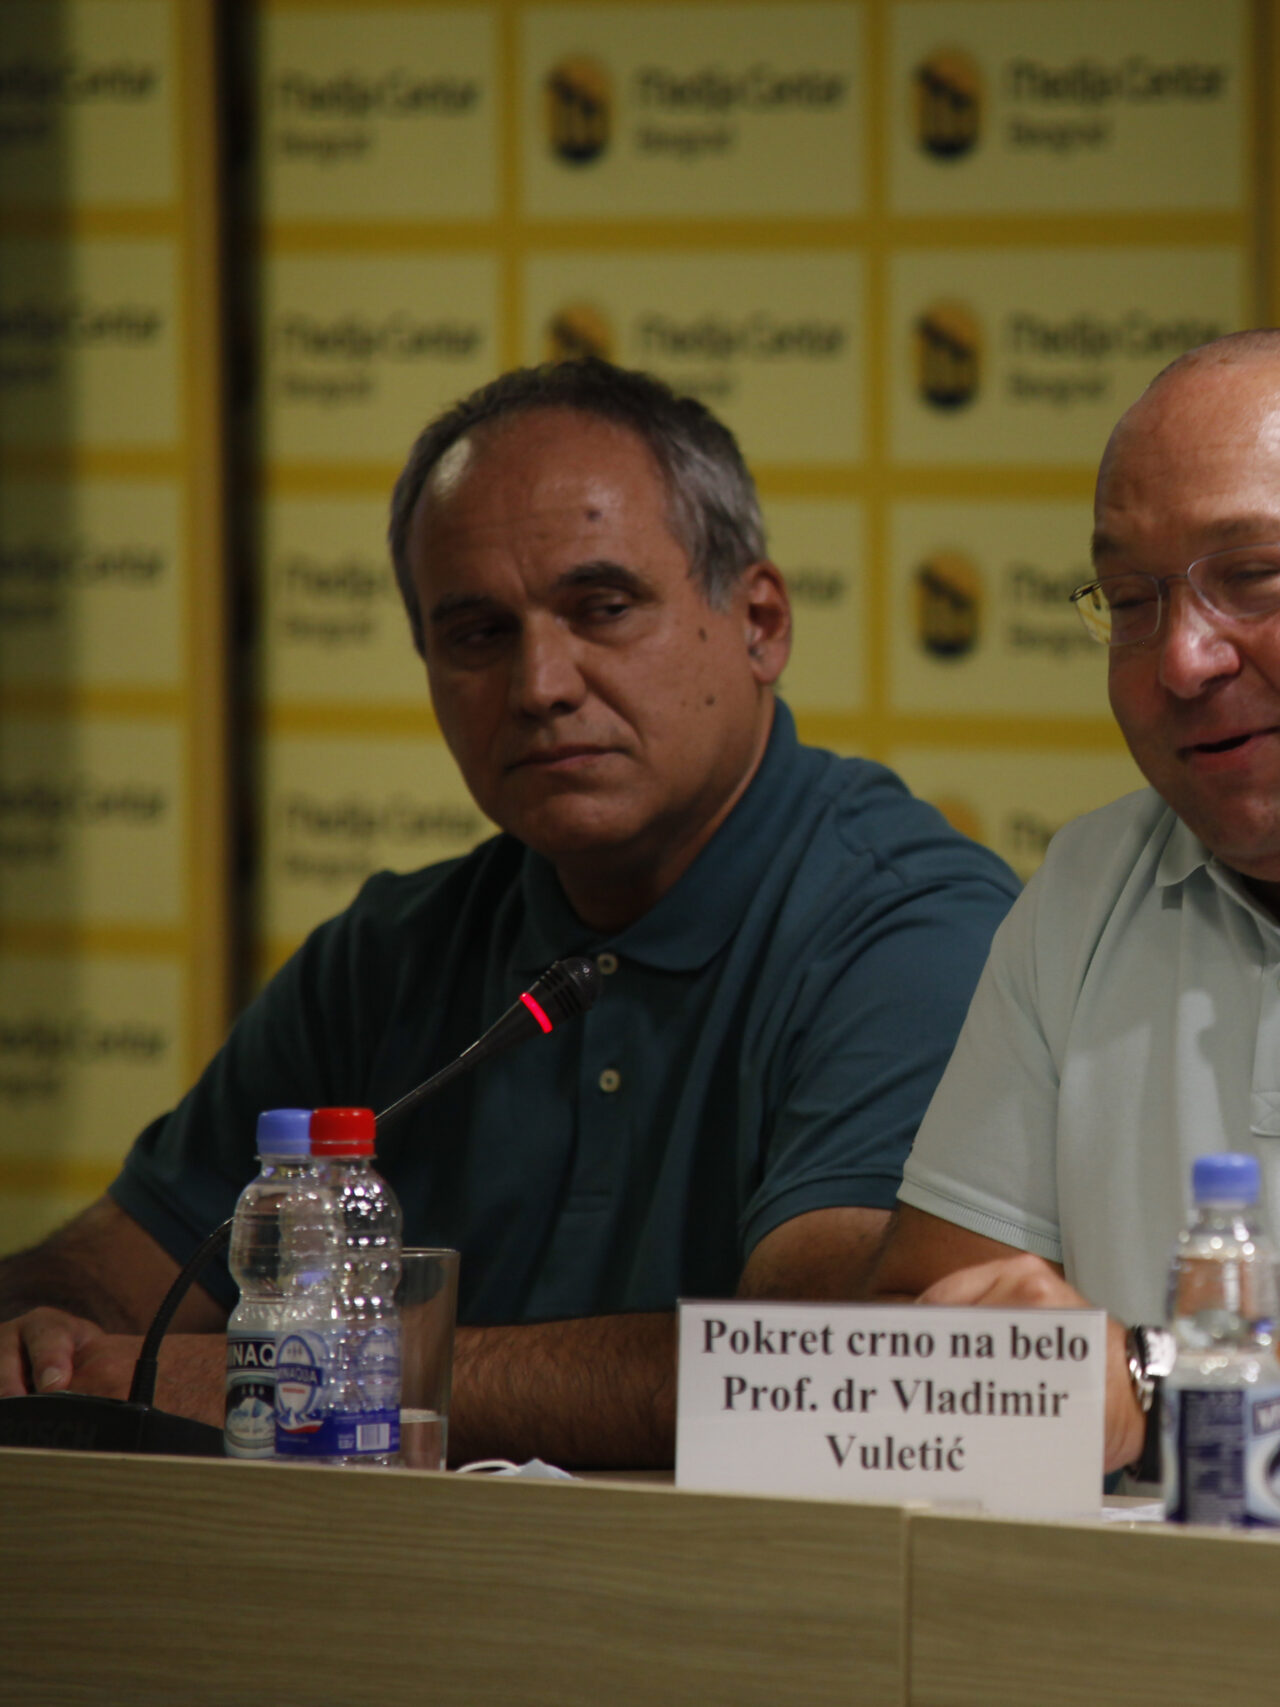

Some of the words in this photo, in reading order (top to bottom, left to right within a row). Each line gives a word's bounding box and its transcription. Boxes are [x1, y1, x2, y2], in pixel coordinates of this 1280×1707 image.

[702, 1319, 833, 1356] Pokret
[847, 1330, 935, 1358] crno
[949, 1331, 995, 1359] na
[1009, 1325, 1090, 1362] belo
[721, 1376, 818, 1412] Prof.
[832, 1378, 878, 1413] dr
[890, 1379, 1069, 1418] Vladimir
[825, 1433, 967, 1472] Vuletić
